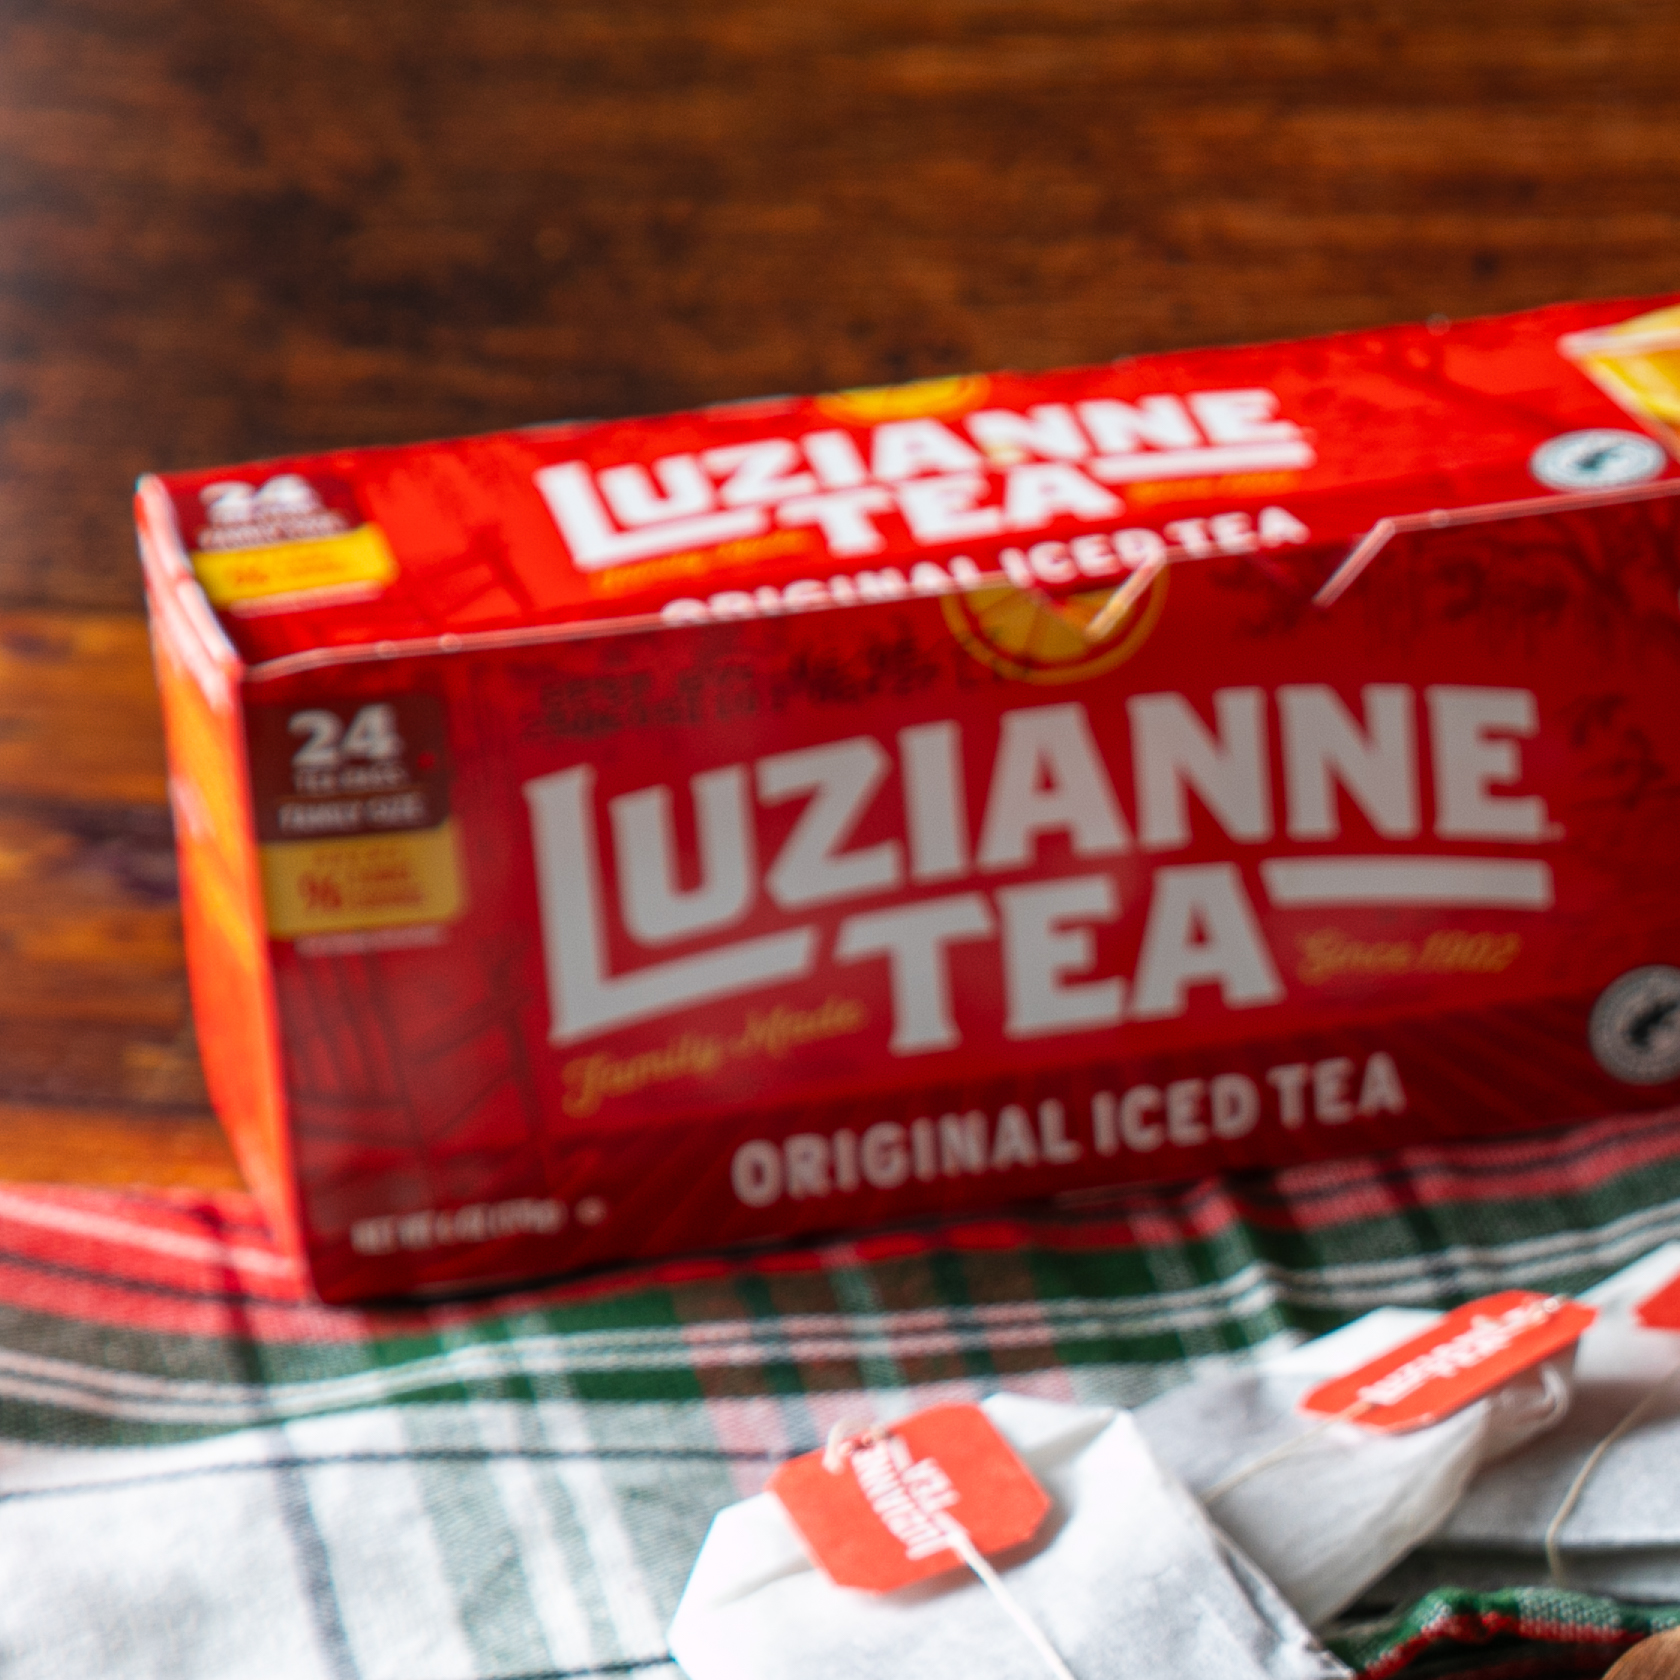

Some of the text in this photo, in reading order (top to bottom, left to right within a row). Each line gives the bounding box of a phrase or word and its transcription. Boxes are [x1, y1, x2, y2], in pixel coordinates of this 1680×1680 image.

[200, 472, 325, 524] 24
[534, 388, 1308, 572] LUZIANNE
[779, 461, 1124, 560] TEA
[1000, 526, 1168, 587] ICED
[1164, 504, 1311, 562] TEA
[286, 700, 406, 769] 24
[521, 684, 1552, 1046] LUZIANNE
[832, 861, 1284, 1057] TEA
[730, 1052, 1407, 1208] ORIGINAL ICED TEA
